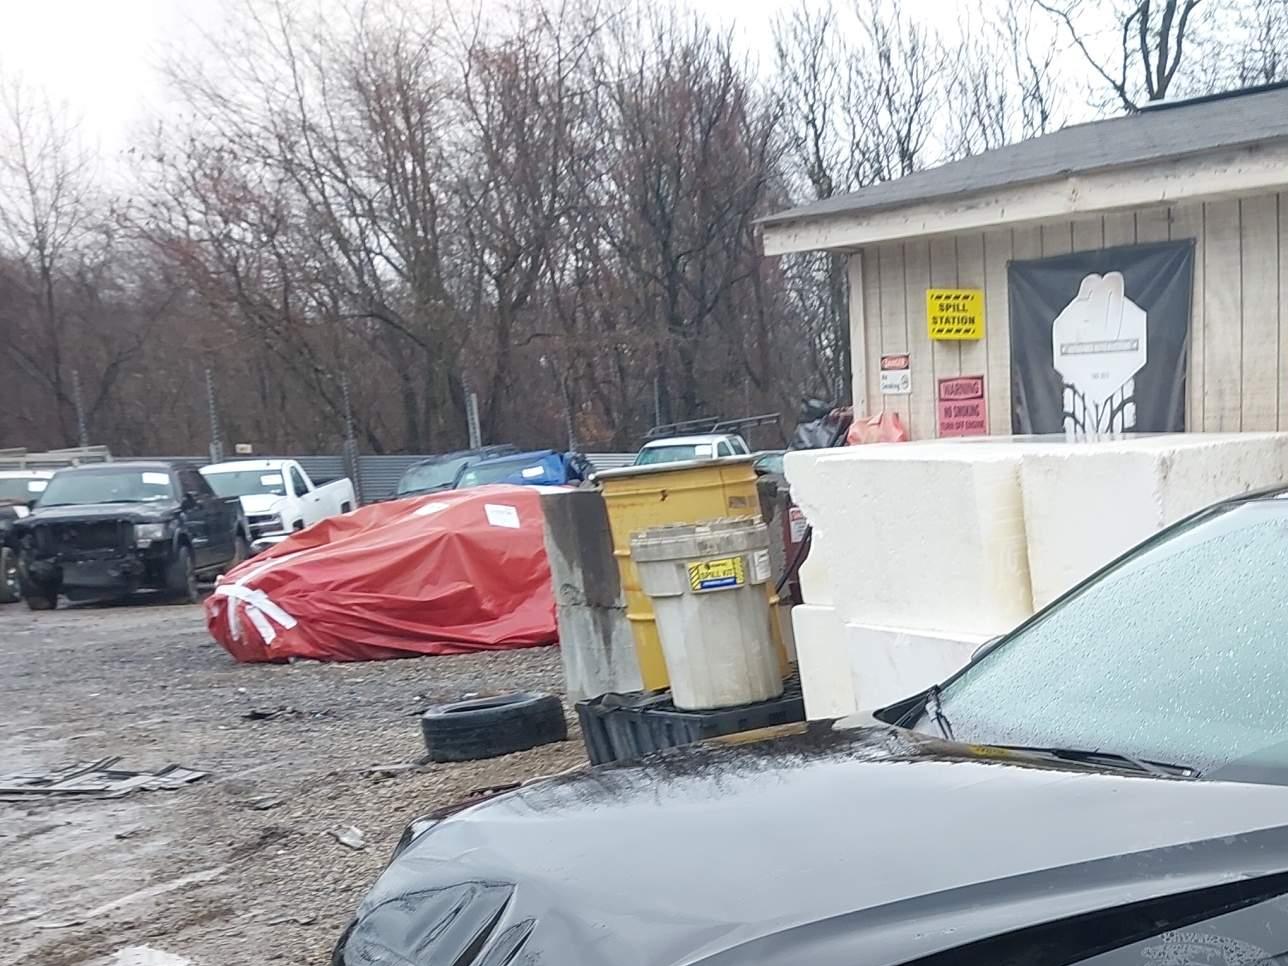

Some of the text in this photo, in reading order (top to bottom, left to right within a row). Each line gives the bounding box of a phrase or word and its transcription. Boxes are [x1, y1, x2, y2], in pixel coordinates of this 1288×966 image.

[938, 302, 968, 312] SPILL
[932, 315, 976, 325] STATION
[943, 381, 979, 396] WARNING
